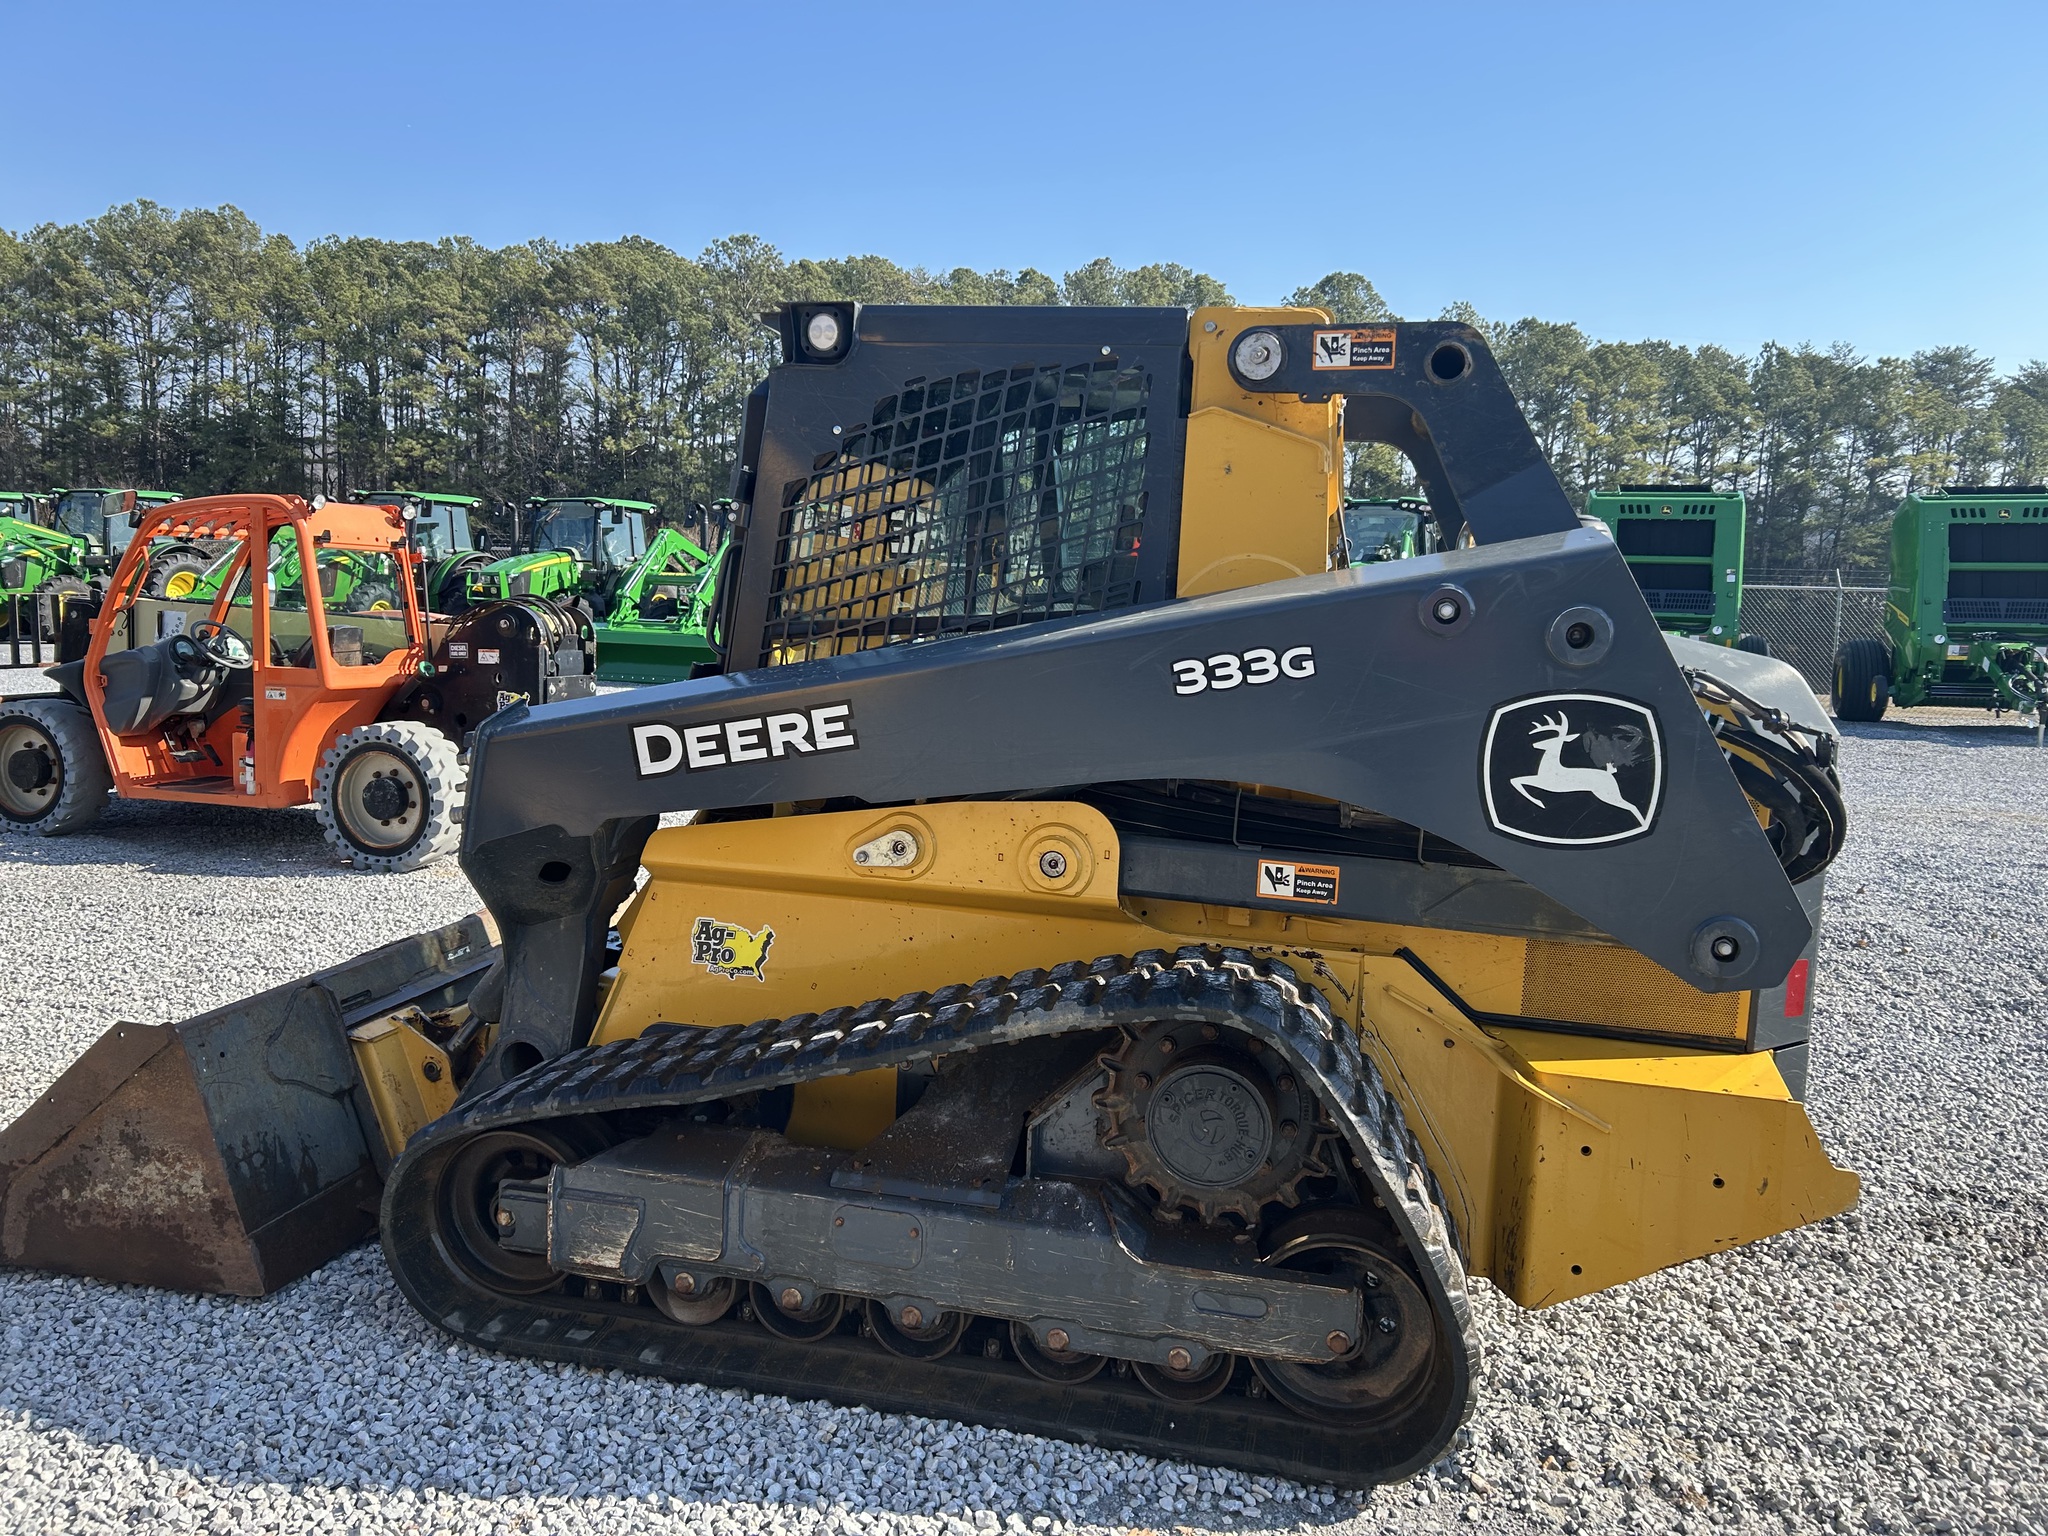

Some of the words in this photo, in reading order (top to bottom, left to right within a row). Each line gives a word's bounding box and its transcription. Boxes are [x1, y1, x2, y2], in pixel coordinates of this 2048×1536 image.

[1172, 647, 1315, 695] 333G
[633, 704, 855, 776] DEERE
[1304, 867, 1335, 875] WARNING
[1296, 879, 1316, 887] Pinch
[1296, 887, 1311, 895] Keep
[694, 920, 735, 947] Ag-
[694, 941, 736, 963] Pro
[709, 965, 754, 975] AgProCo.com
[1168, 1087, 1216, 1125] SPICER
